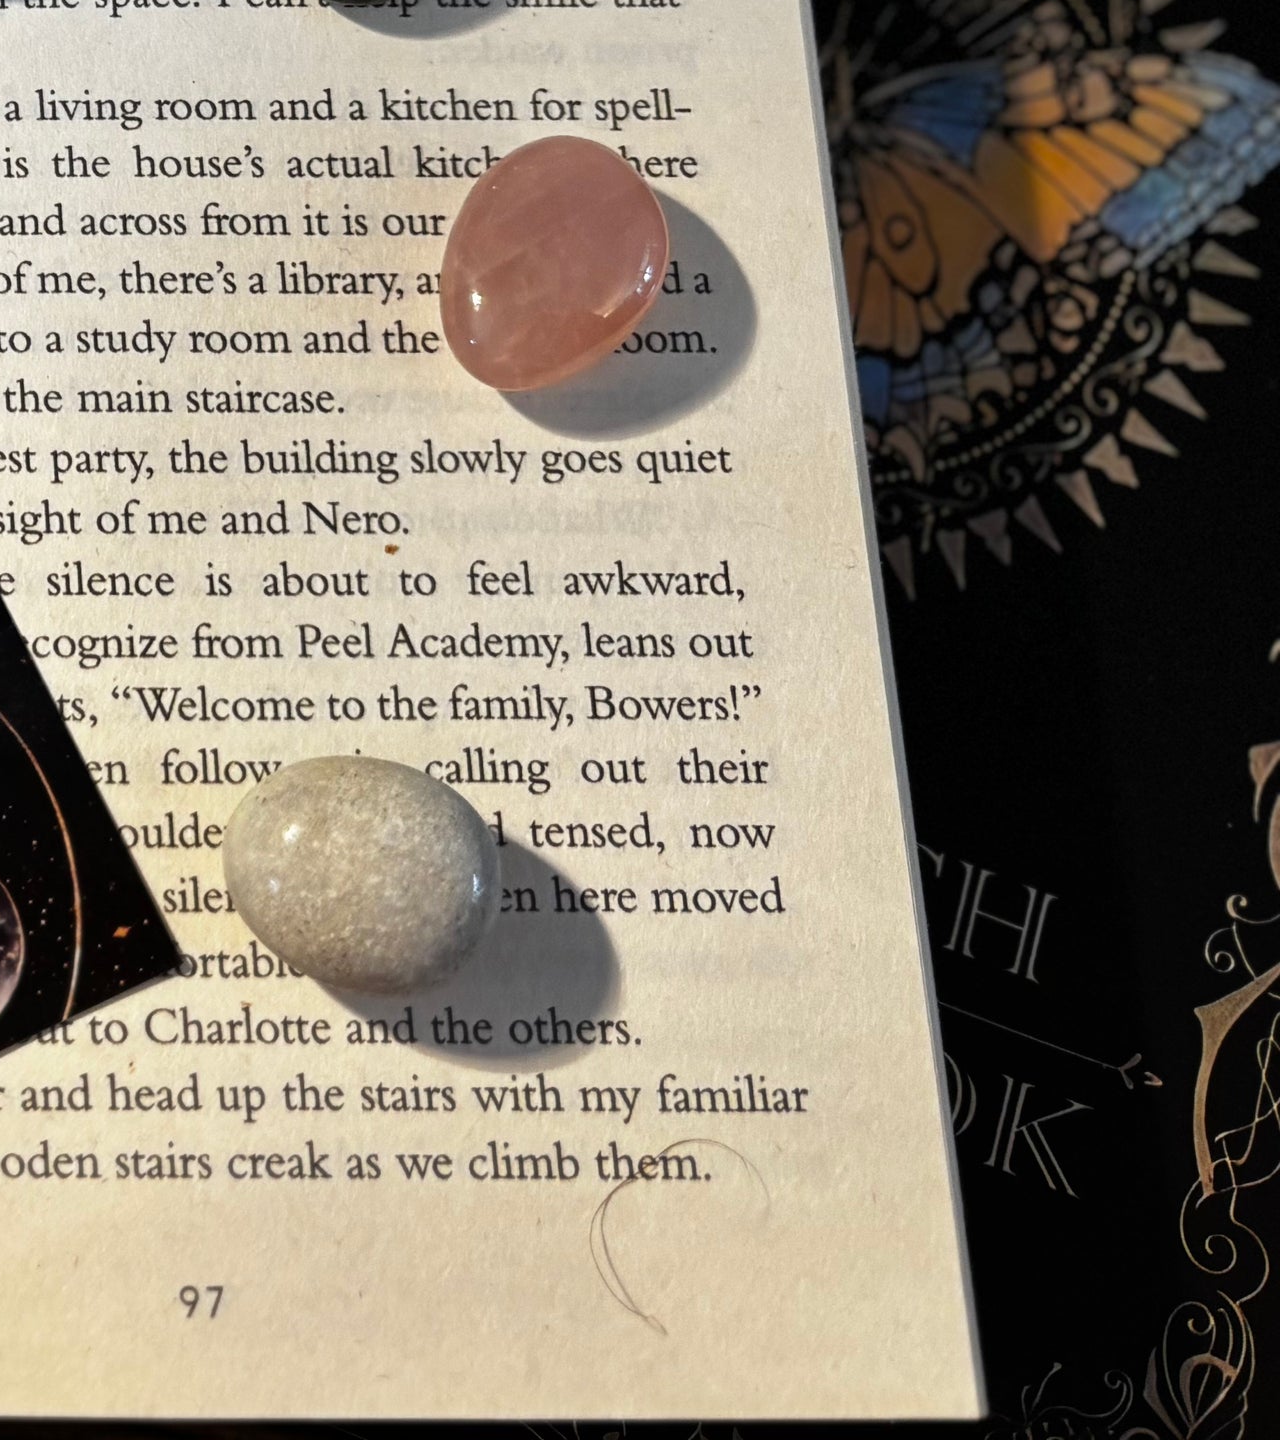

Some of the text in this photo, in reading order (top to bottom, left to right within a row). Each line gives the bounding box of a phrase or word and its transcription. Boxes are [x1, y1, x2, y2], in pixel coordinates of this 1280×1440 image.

[2, 99, 25, 124] a
[33, 87, 145, 133] living
[152, 97, 259, 123] room
[267, 86, 339, 123] and
[347, 98, 370, 123] a
[377, 86, 521, 123] kitchen
[527, 86, 584, 123] for
[593, 86, 693, 133] spell-
[78, 212, 189, 237] across
[198, 200, 293, 238] from
[301, 202, 332, 238] it
[339, 202, 370, 238] is
[380, 212, 448, 238] our
[48, 437, 734, 486] party, the building slowly goes quiet
[110, 681, 763, 733] “Welcome to the family, Bowers!”
[114, 1139, 214, 1181] stairs
[226, 1138, 334, 1181] creak
[345, 1152, 383, 1182] as
[393, 1152, 454, 1182] we
[467, 1138, 582, 1183] climb
[591, 1138, 713, 1183] them.
[178, 1284, 225, 1320] 97
